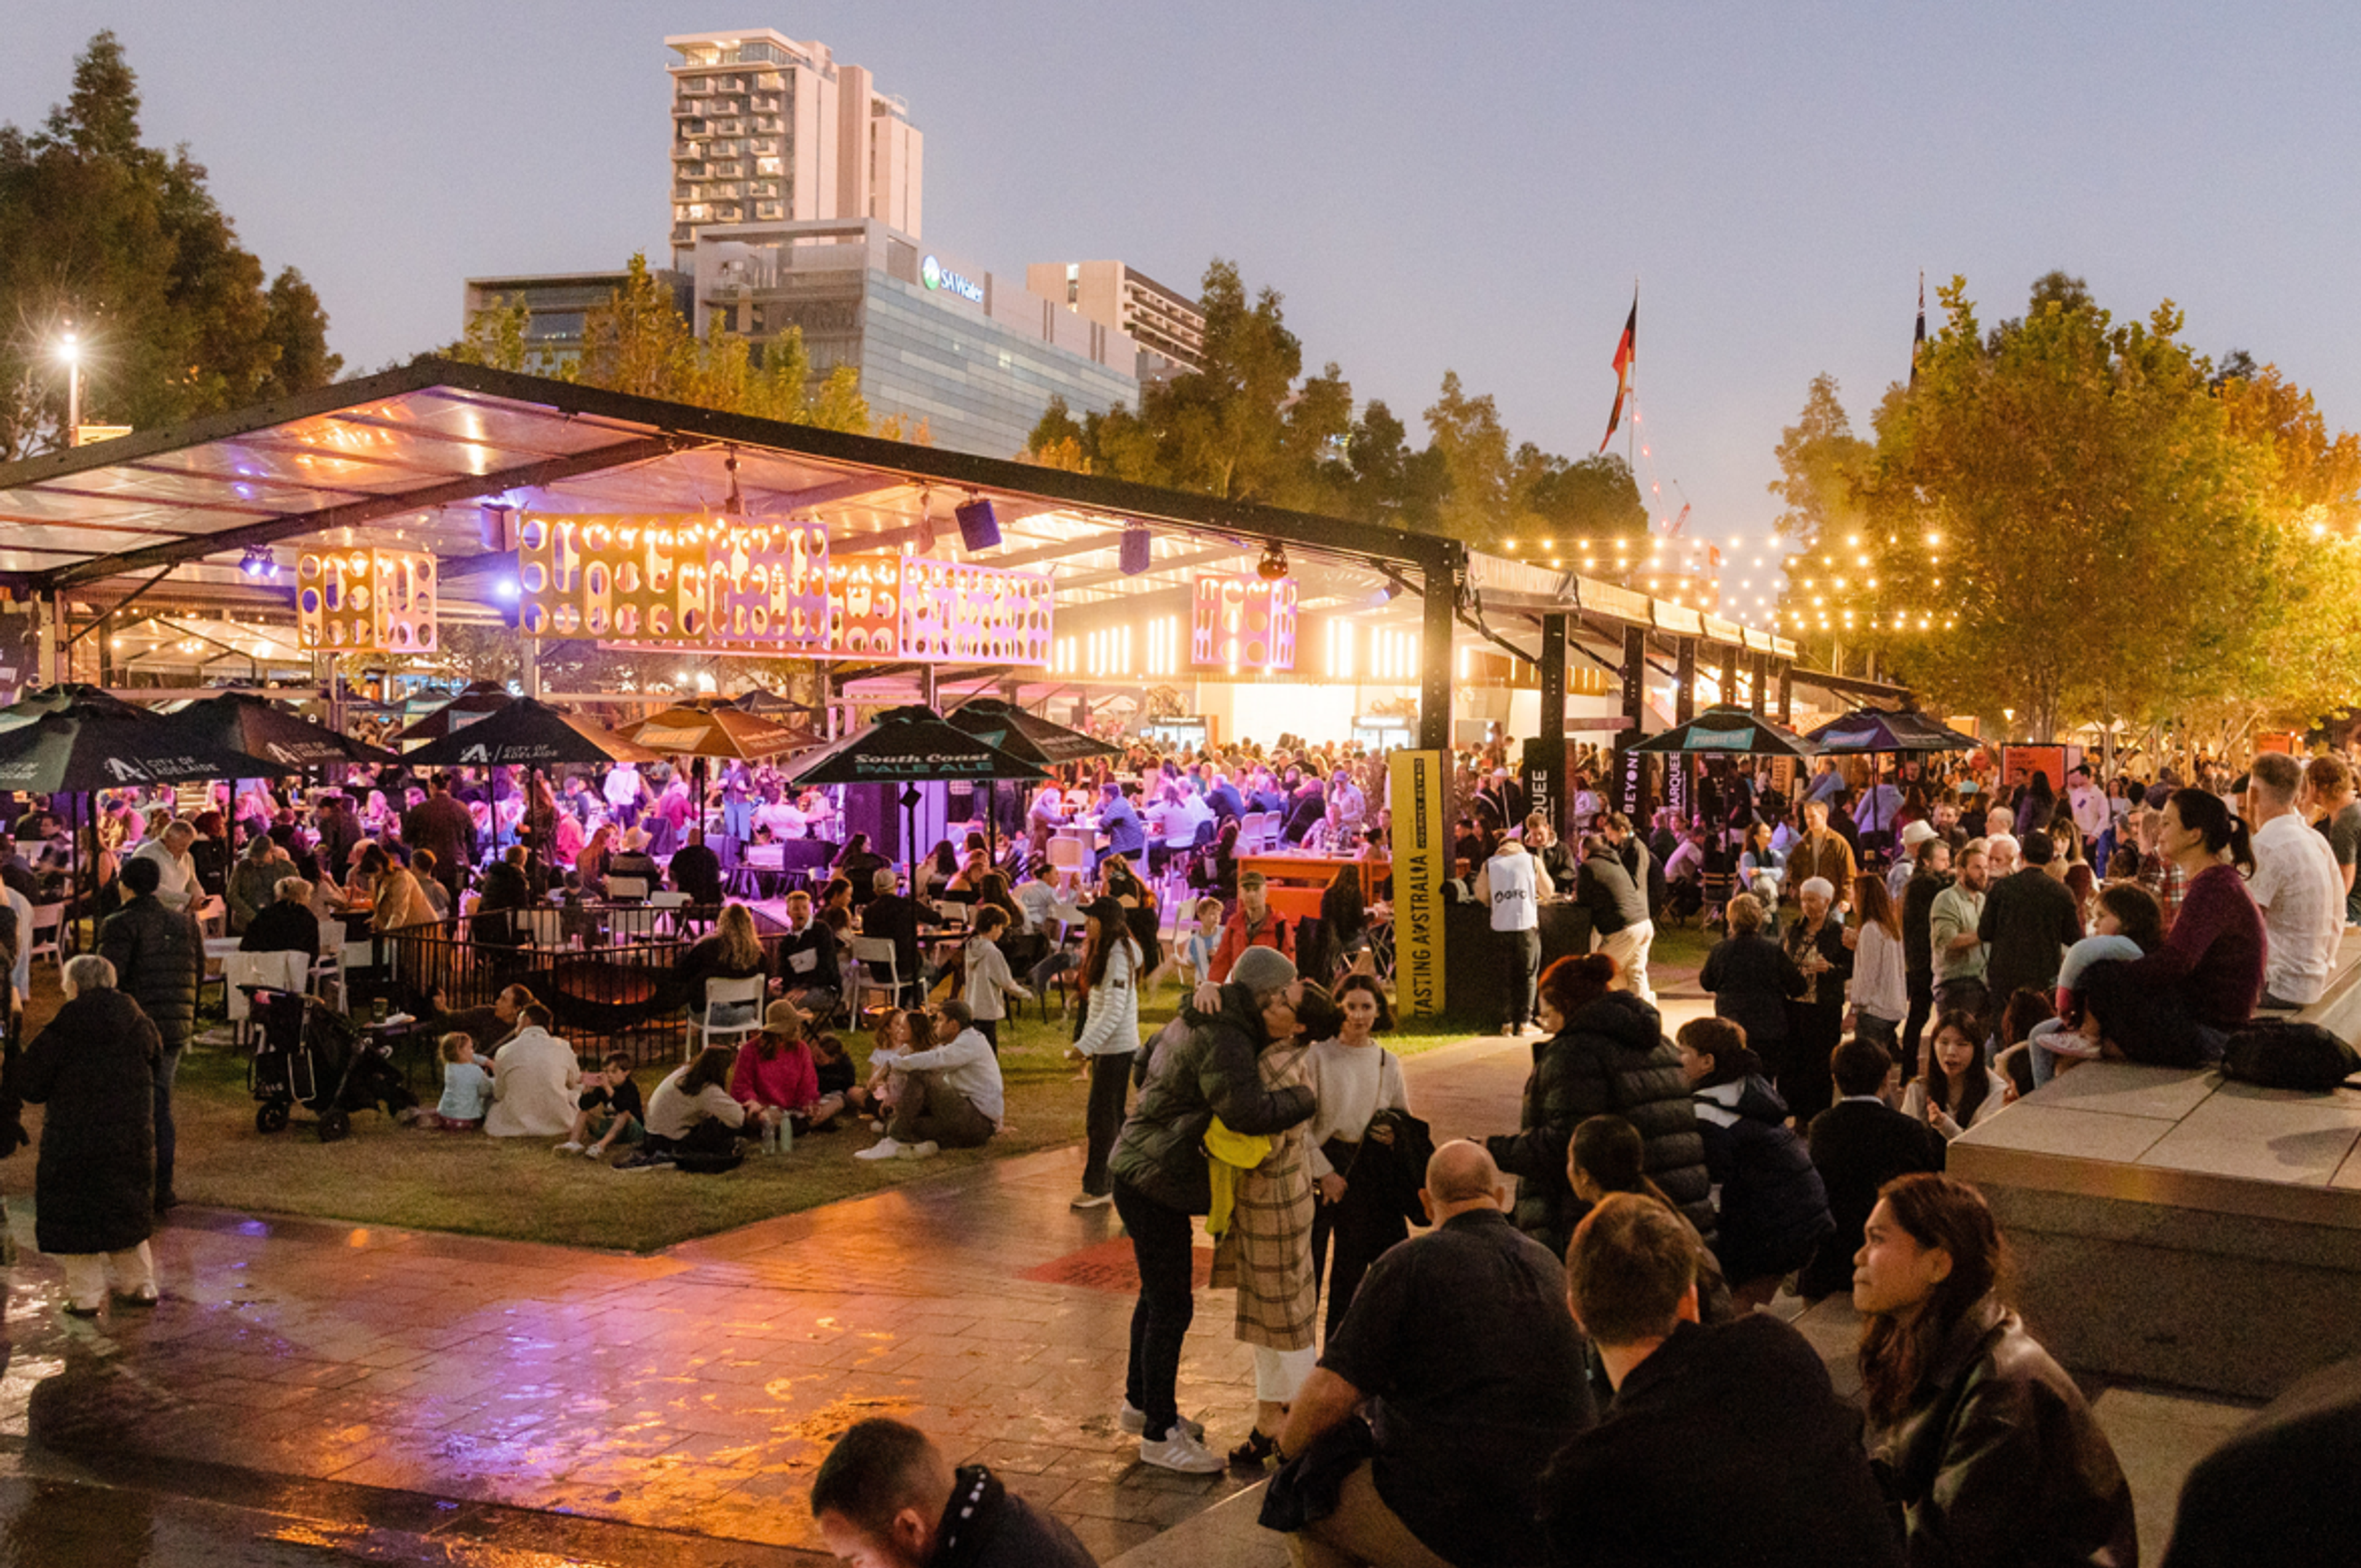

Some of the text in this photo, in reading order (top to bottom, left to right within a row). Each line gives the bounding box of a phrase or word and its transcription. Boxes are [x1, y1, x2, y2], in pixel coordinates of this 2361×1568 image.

[941, 267, 984, 304] SA Water
[854, 753, 991, 763] South Coast
[856, 762, 994, 773] PALE ALE
[1532, 770, 1549, 816] QUEE
[1412, 948, 1433, 1016] TASTING
